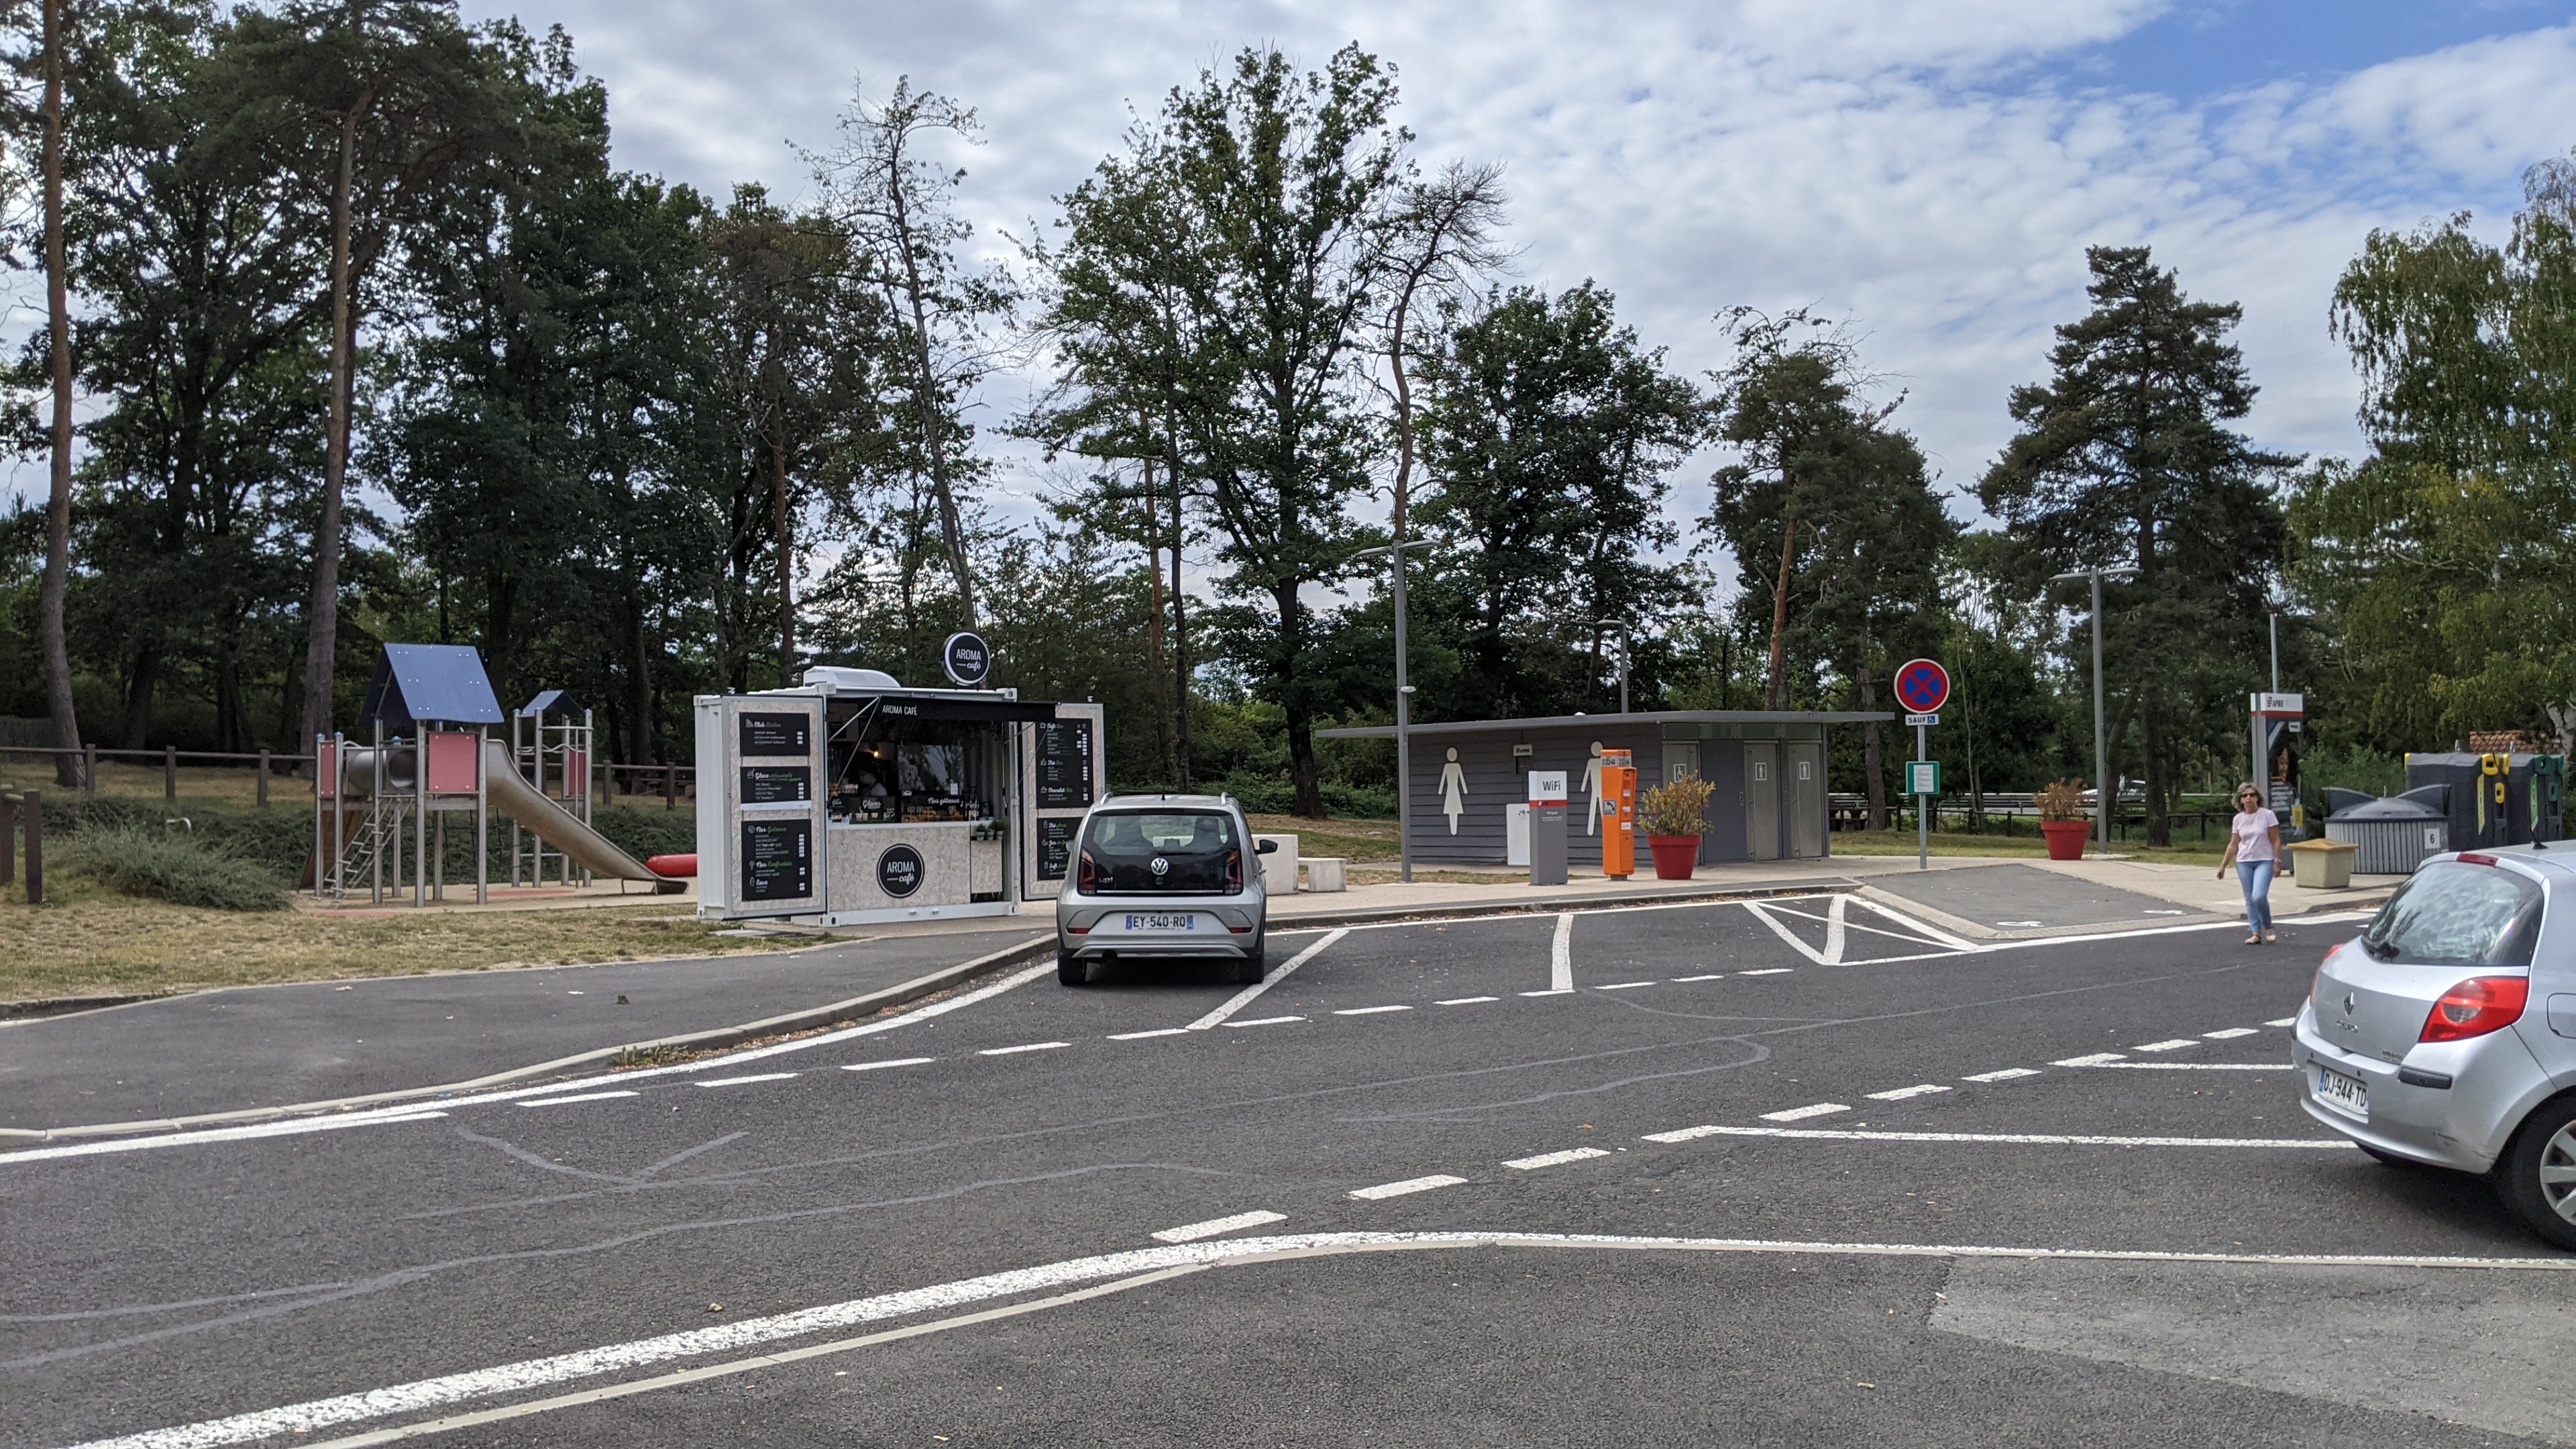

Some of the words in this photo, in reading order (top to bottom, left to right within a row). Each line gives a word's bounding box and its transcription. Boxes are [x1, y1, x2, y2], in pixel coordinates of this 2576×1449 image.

[956, 649, 981, 661] AROMA
[967, 661, 981, 672] café
[882, 704, 903, 714] AROMA
[904, 705, 918, 716] CAFÉ
[1542, 780, 1561, 792] WiFi
[2430, 833, 2435, 844] 6
[887, 861, 915, 873] AROMA
[899, 873, 915, 885] café
[2323, 1073, 2367, 1108] DJ-944-TD
